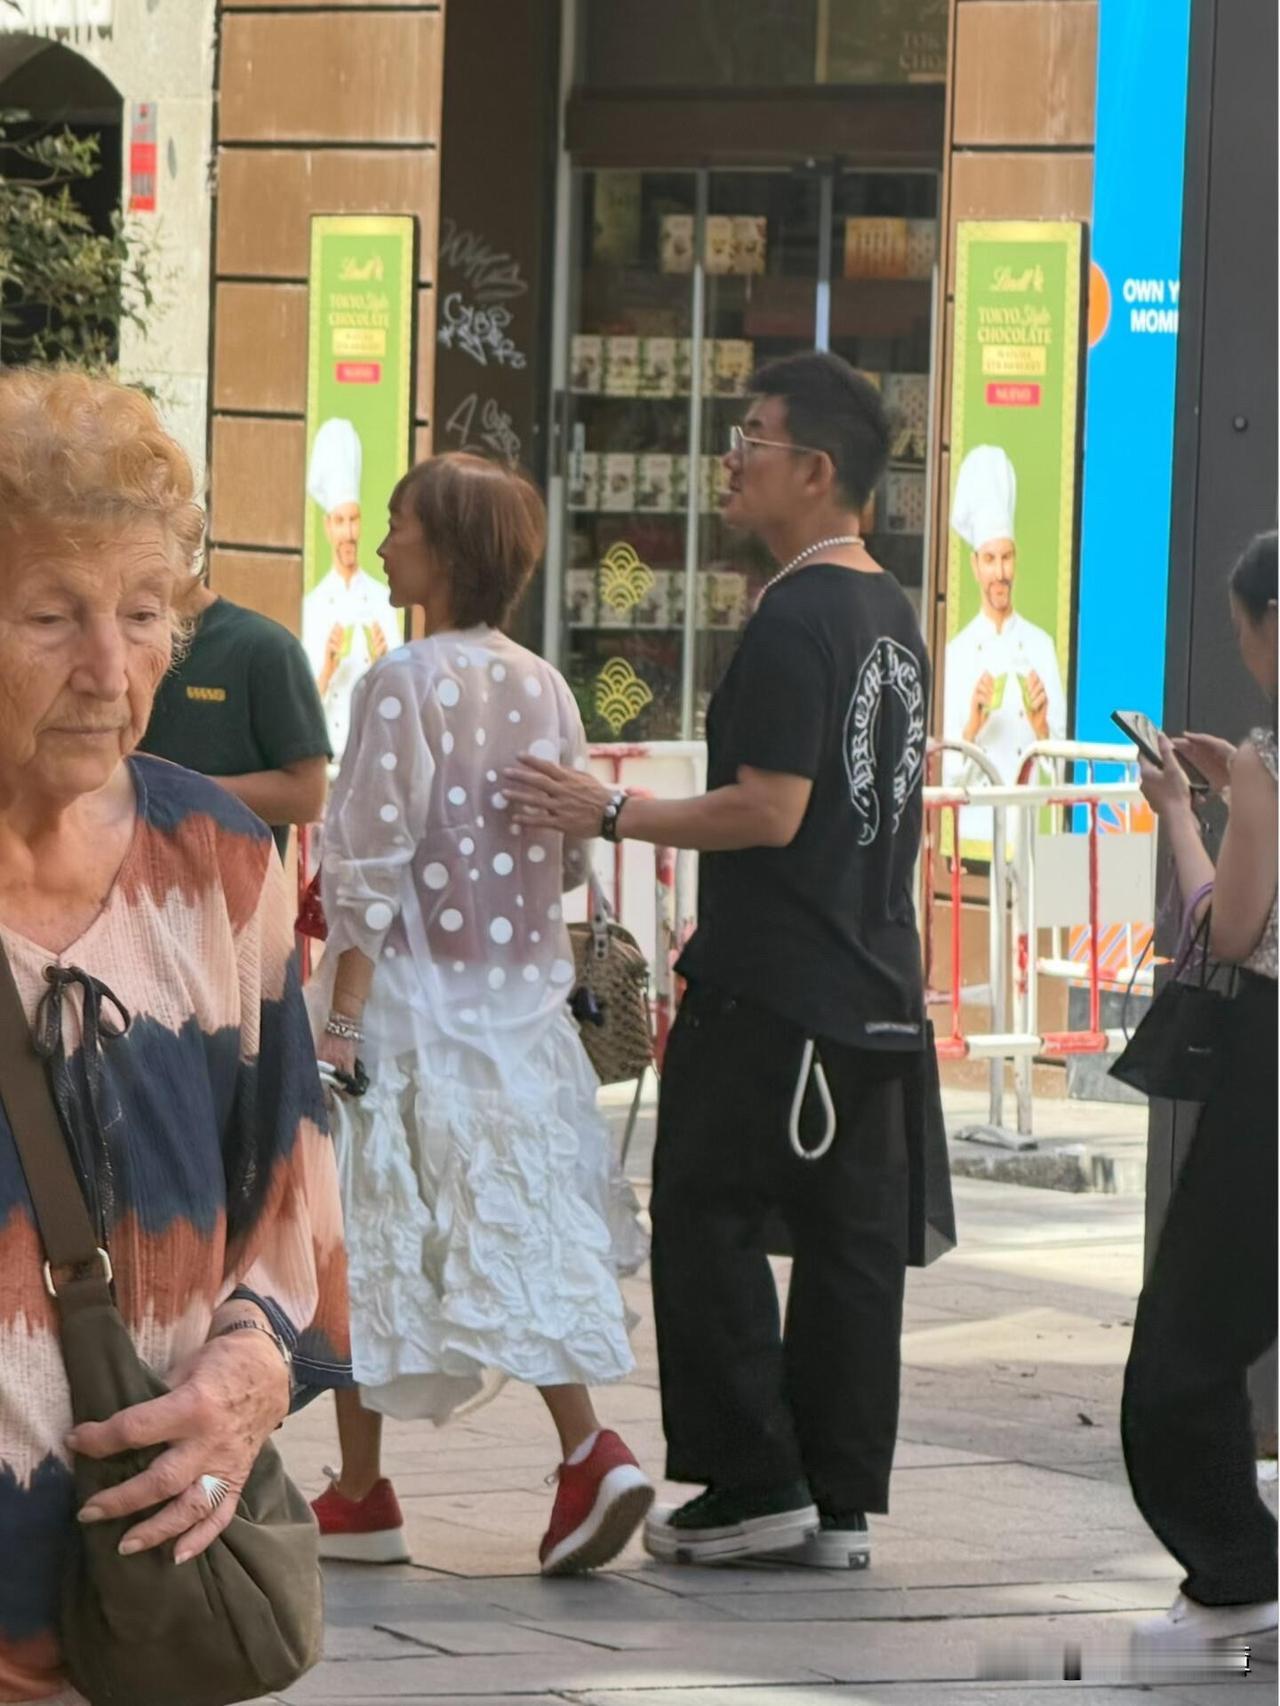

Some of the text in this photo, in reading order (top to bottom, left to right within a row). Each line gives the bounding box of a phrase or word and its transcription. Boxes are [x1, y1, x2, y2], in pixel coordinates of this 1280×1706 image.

[1123, 278, 1164, 303] OWN
[978, 306, 1020, 325] TOKYO
[977, 326, 1052, 345] CHOCOLATE
